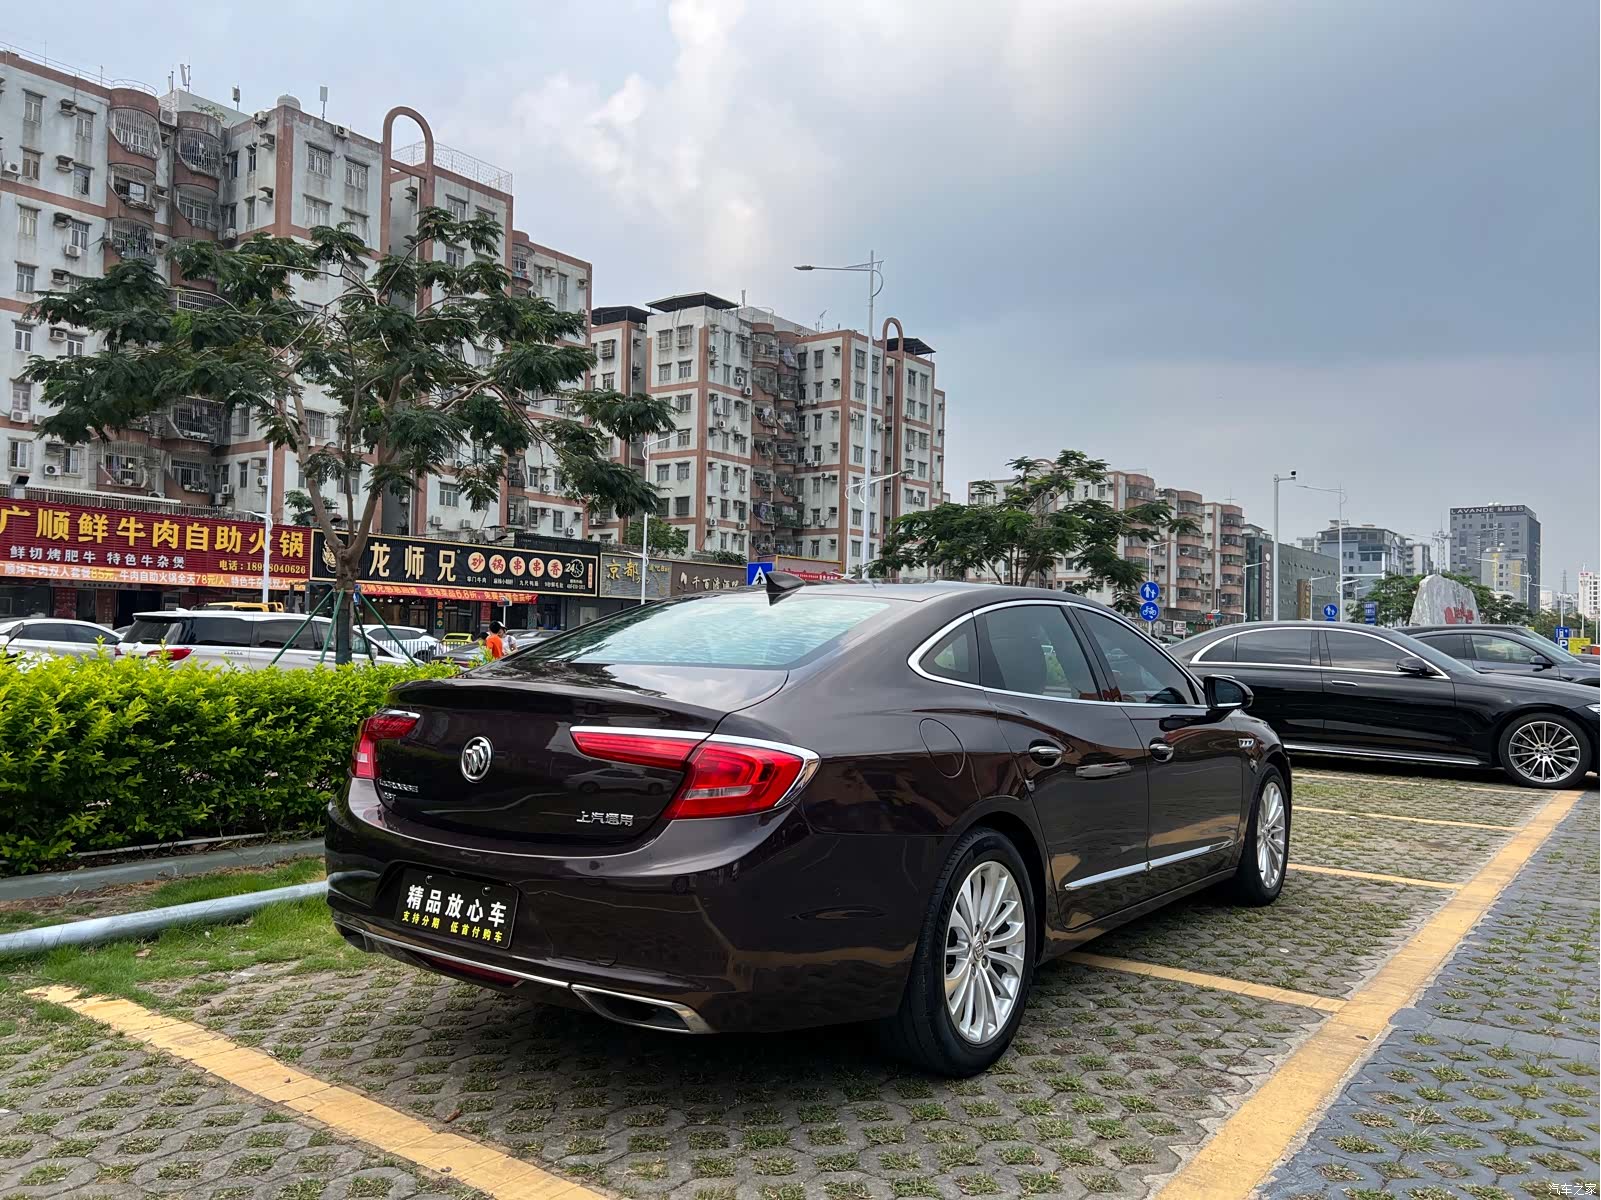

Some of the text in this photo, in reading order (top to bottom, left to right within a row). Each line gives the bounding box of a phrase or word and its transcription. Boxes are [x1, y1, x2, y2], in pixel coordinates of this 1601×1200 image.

[1451, 507, 1494, 515] LAVANDE
[0, 505, 304, 558] 广顺鲜牛肉自助火锅
[10, 545, 185, 570] 鲜切烤肥牛 特色牛杂煲
[369, 542, 456, 582] 龙师兄
[606, 558, 639, 582] 京都
[576, 810, 634, 827] 上汽通用
[406, 884, 508, 928] 精品放心车
[401, 911, 504, 944] 支持分期 低首付购车
